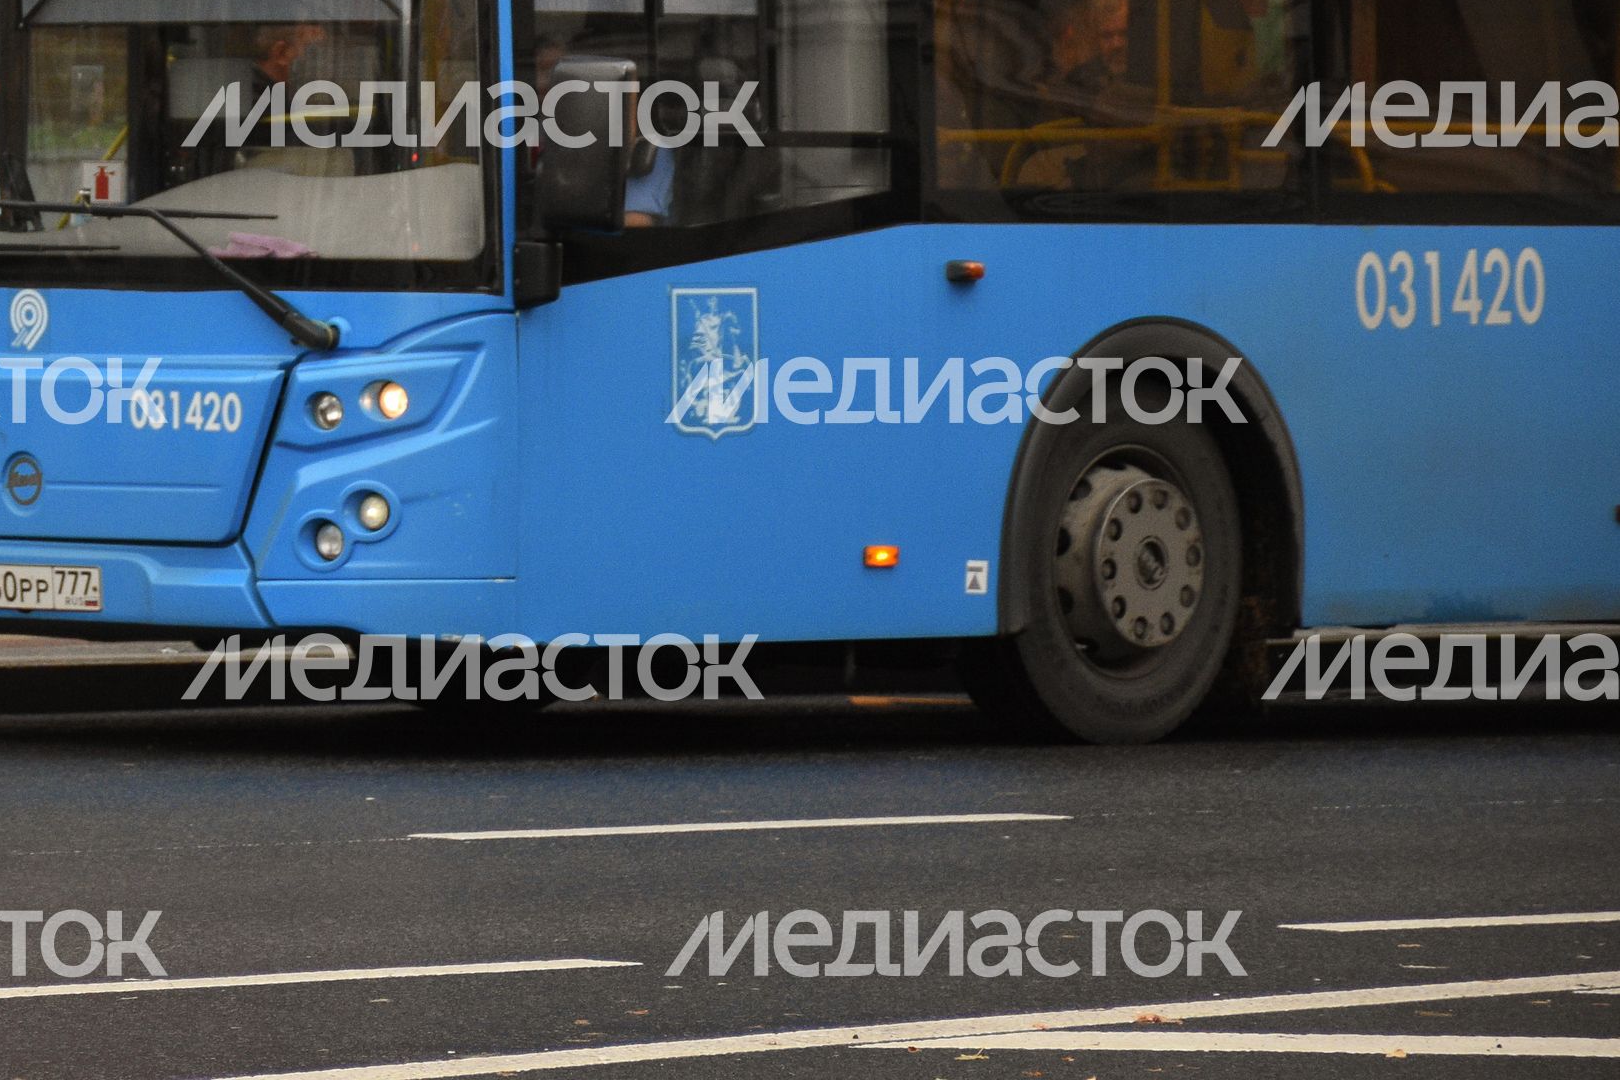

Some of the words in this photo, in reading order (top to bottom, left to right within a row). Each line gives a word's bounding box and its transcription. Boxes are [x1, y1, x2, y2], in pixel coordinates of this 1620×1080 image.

[1356, 247, 1545, 330] 031420
[130, 388, 242, 432] 031420
[54, 571, 92, 596] 777
